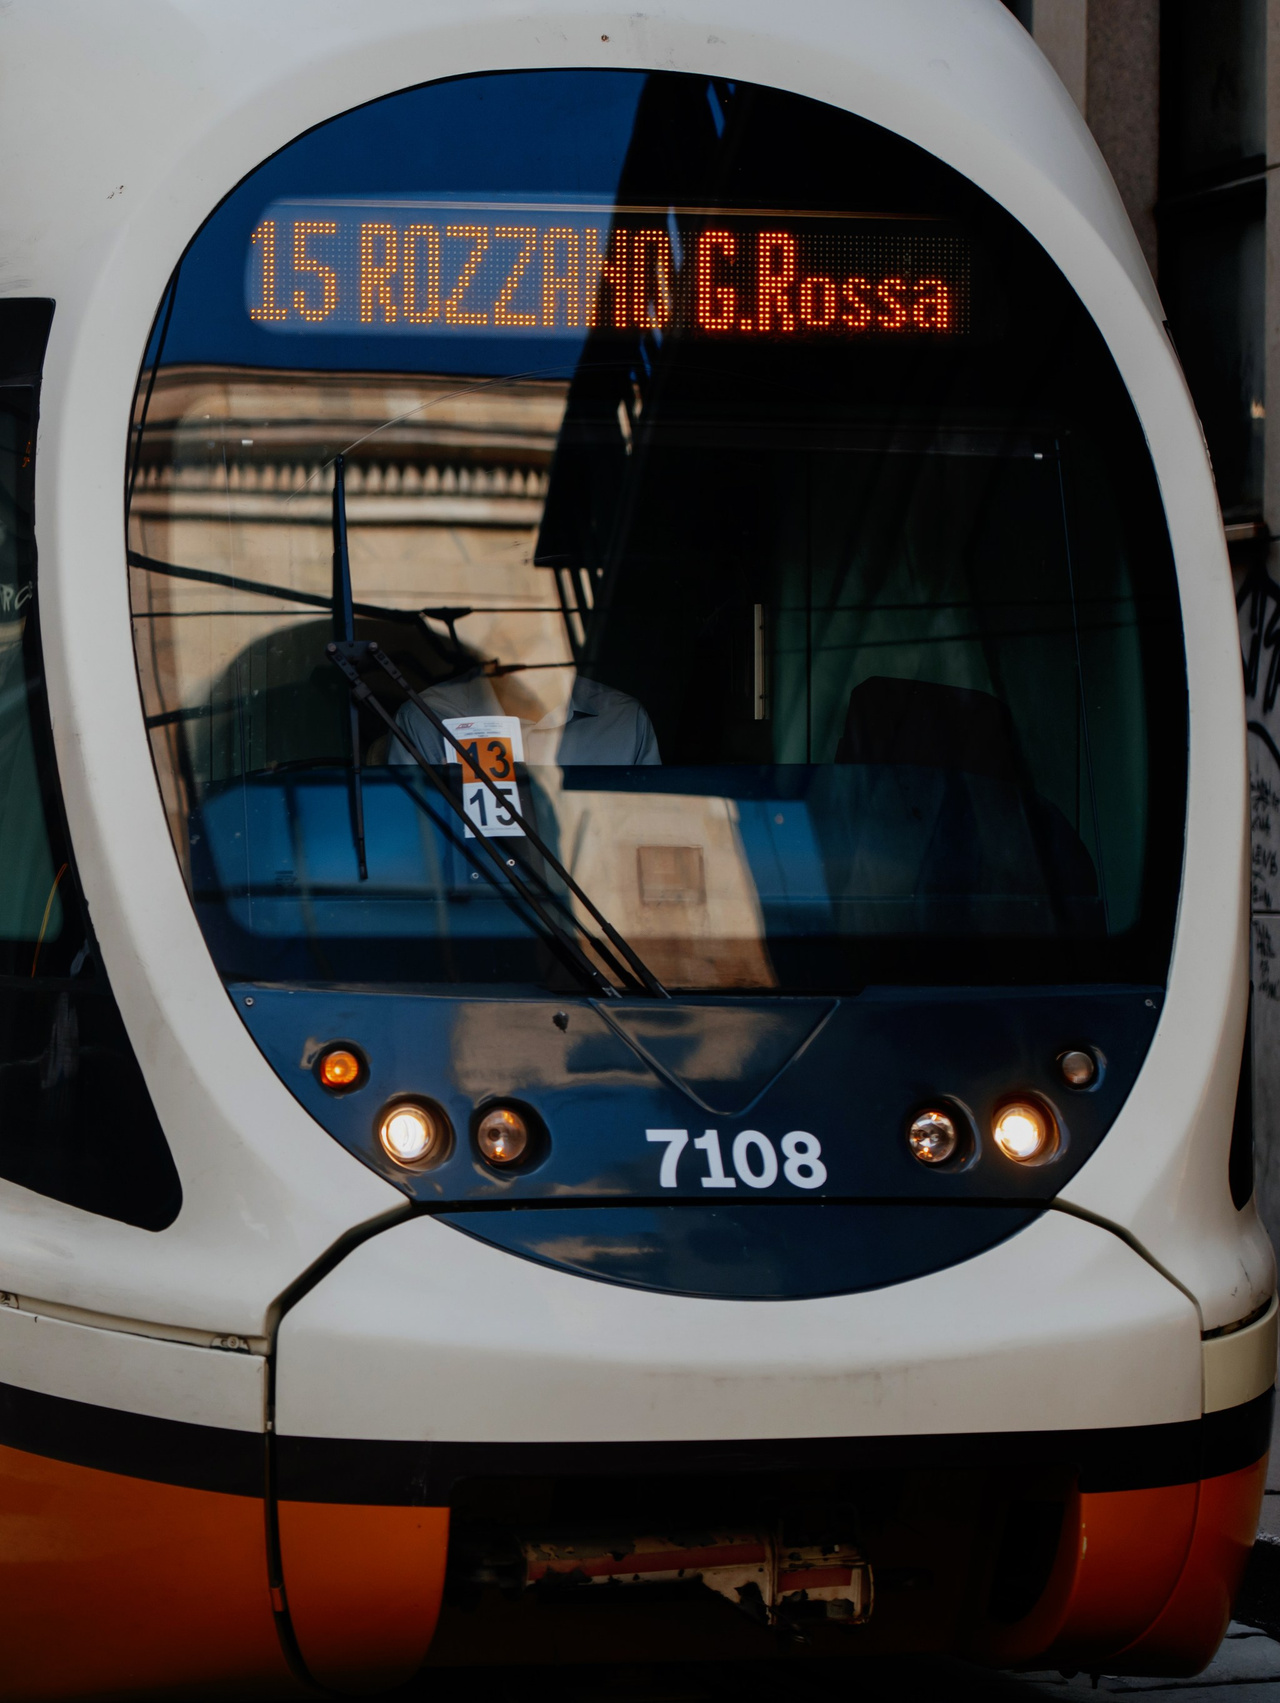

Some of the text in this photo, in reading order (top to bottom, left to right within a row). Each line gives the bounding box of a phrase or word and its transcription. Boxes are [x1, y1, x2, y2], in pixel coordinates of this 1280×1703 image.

[250, 220, 949, 332] 15 ROZZANO G.Rossa
[465, 740, 511, 780] 13
[469, 788, 517, 826] 15
[645, 1128, 828, 1190] 7108
